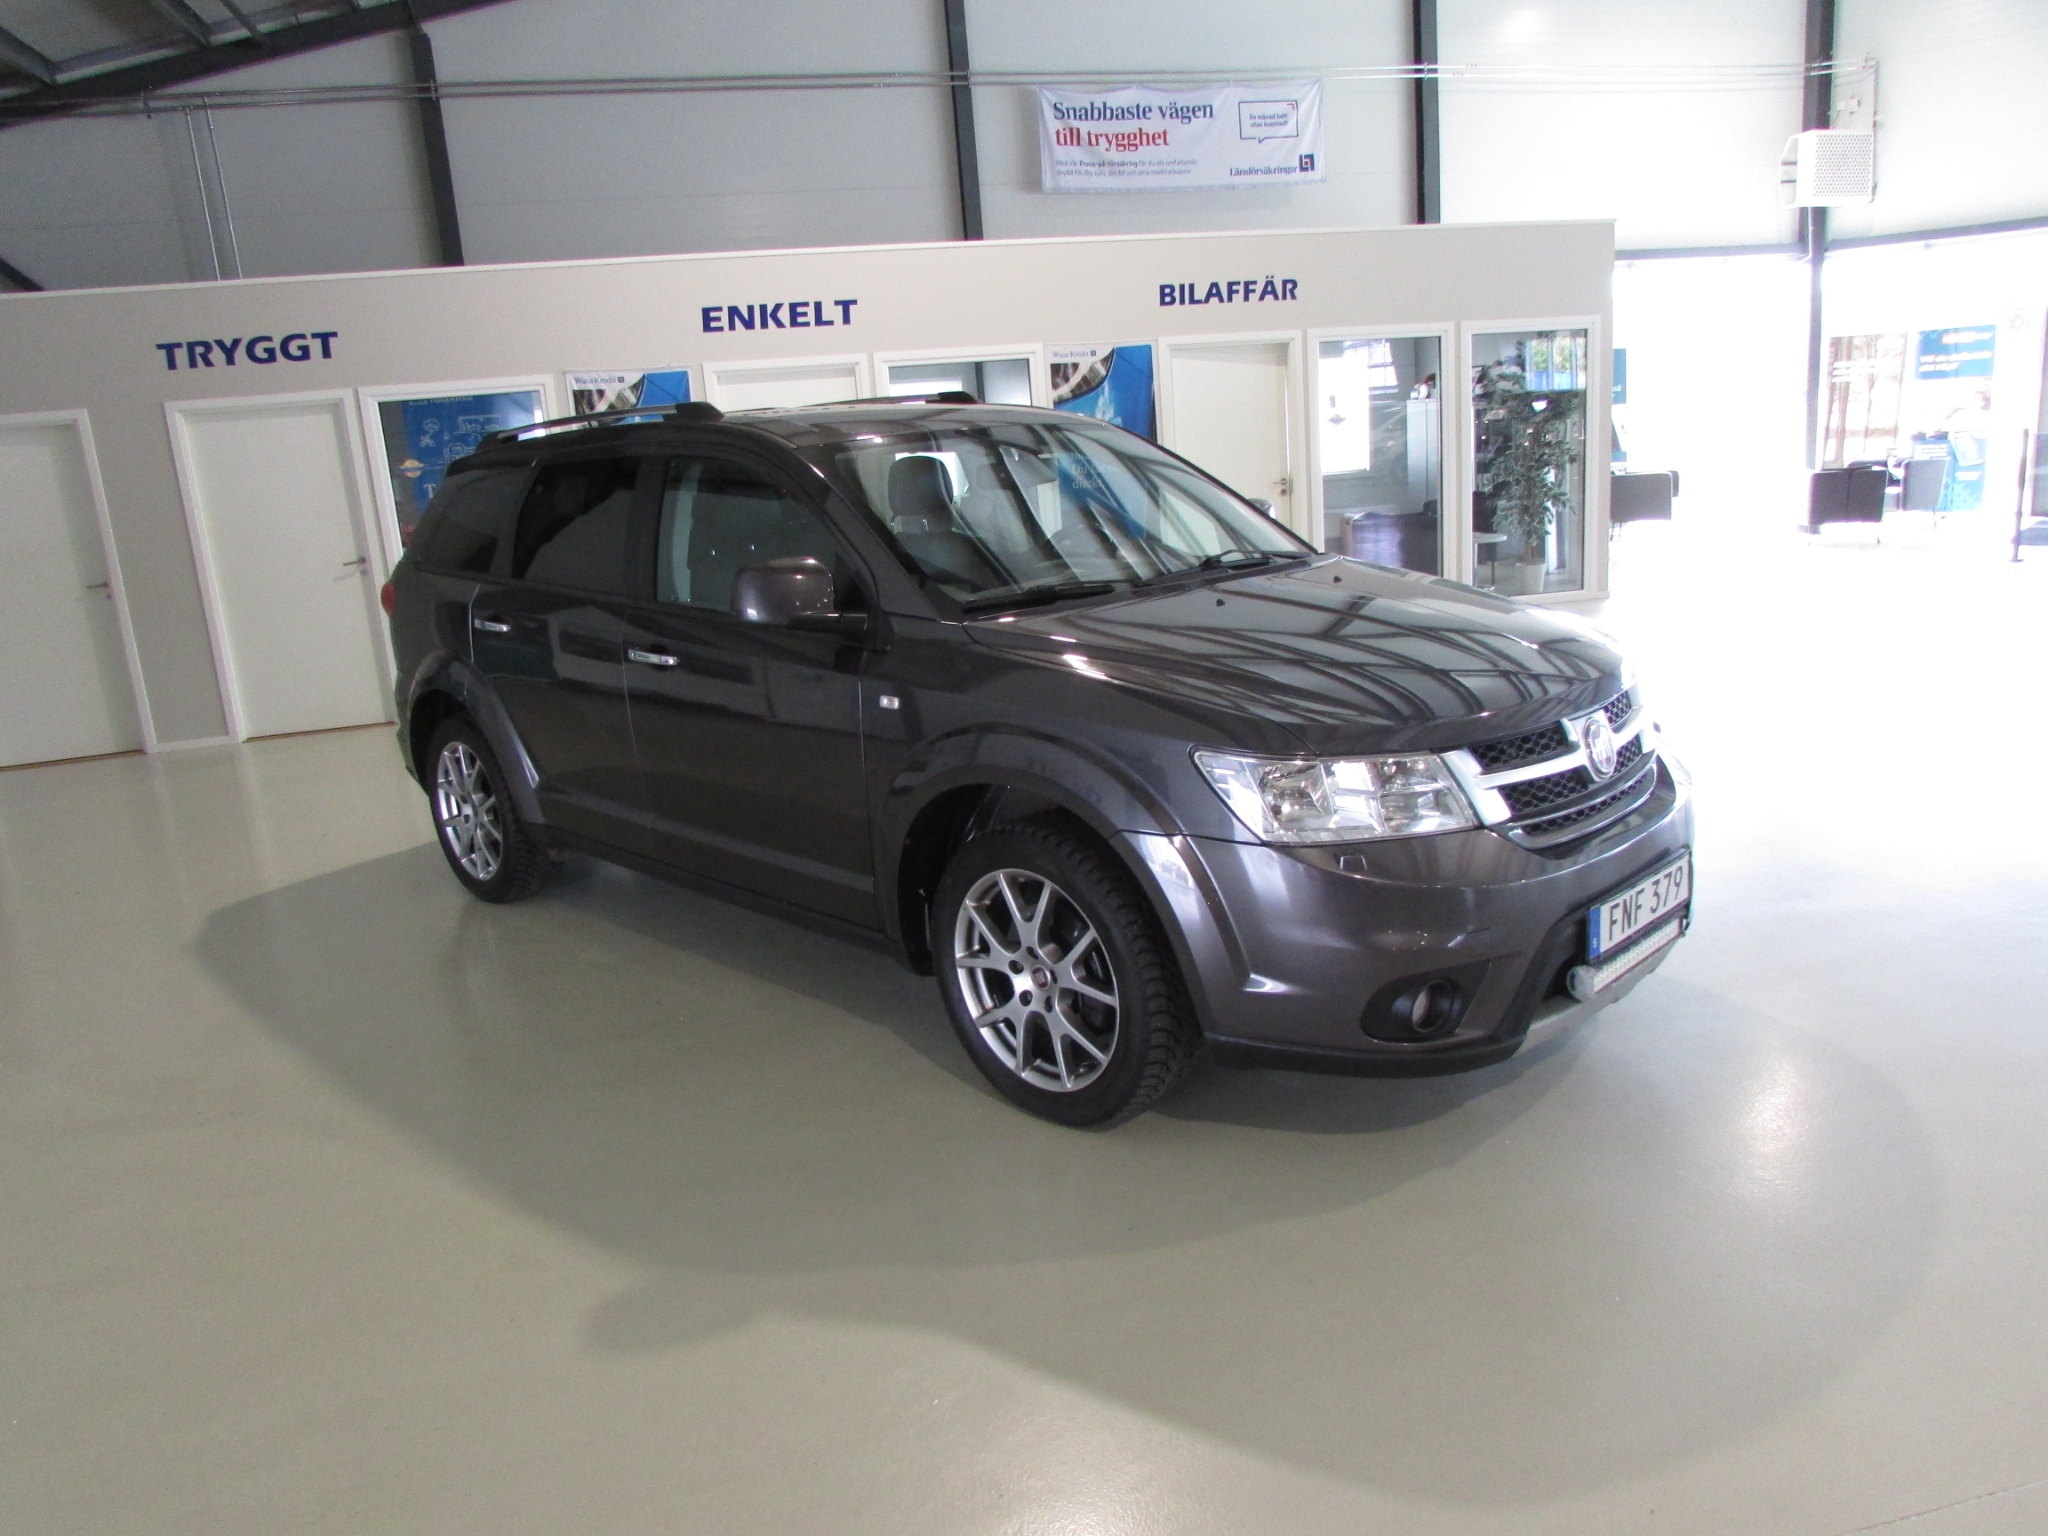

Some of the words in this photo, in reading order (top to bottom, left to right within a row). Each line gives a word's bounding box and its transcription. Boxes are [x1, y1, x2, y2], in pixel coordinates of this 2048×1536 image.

[1053, 101, 1152, 122] Snabbaste
[1158, 102, 1215, 124] vägen
[1055, 127, 1081, 147] till
[1086, 127, 1170, 152] trygghet
[1229, 165, 1298, 177] Länsförsäkringar
[1159, 275, 1298, 307] BILAFFÄR
[701, 299, 858, 333] ENKELT
[155, 331, 339, 371] TRYGGT
[1069, 350, 1089, 358] Kredit
[594, 376, 616, 384] Kredit
[1608, 887, 1646, 942] FNF
[1649, 865, 1684, 914] 379
[1592, 937, 1598, 948] S
